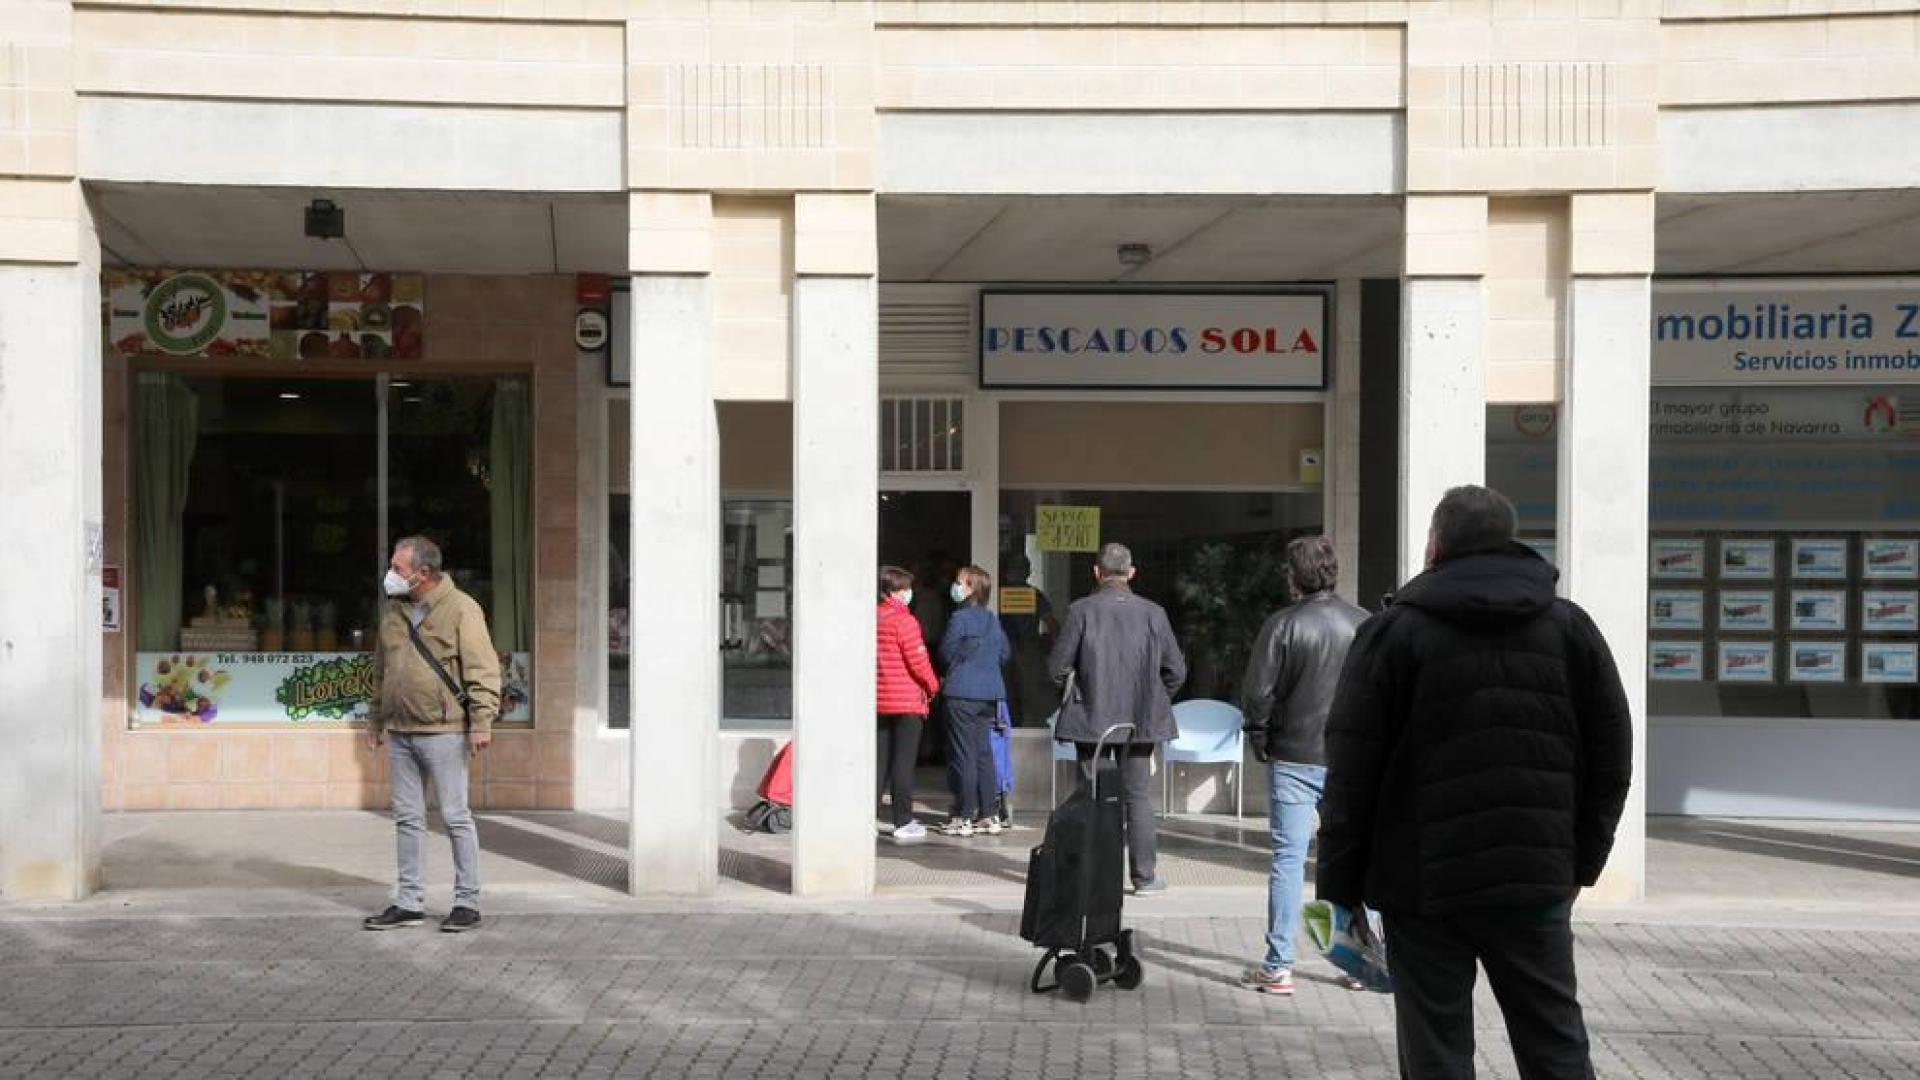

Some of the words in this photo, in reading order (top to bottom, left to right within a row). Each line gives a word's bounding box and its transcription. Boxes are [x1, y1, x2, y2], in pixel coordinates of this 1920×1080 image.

[1657, 304, 1873, 341] mobiliaria
[986, 326, 1190, 354] PESCADOS
[1200, 326, 1320, 354] SOLA
[1734, 351, 1837, 370] Servicios
[1663, 403, 1714, 417] mayor
[1719, 403, 1769, 417] grupo
[1744, 420, 1766, 434] de
[1770, 420, 1841, 434] Navarra
[243, 654, 265, 664] 948
[267, 654, 288, 664] 072
